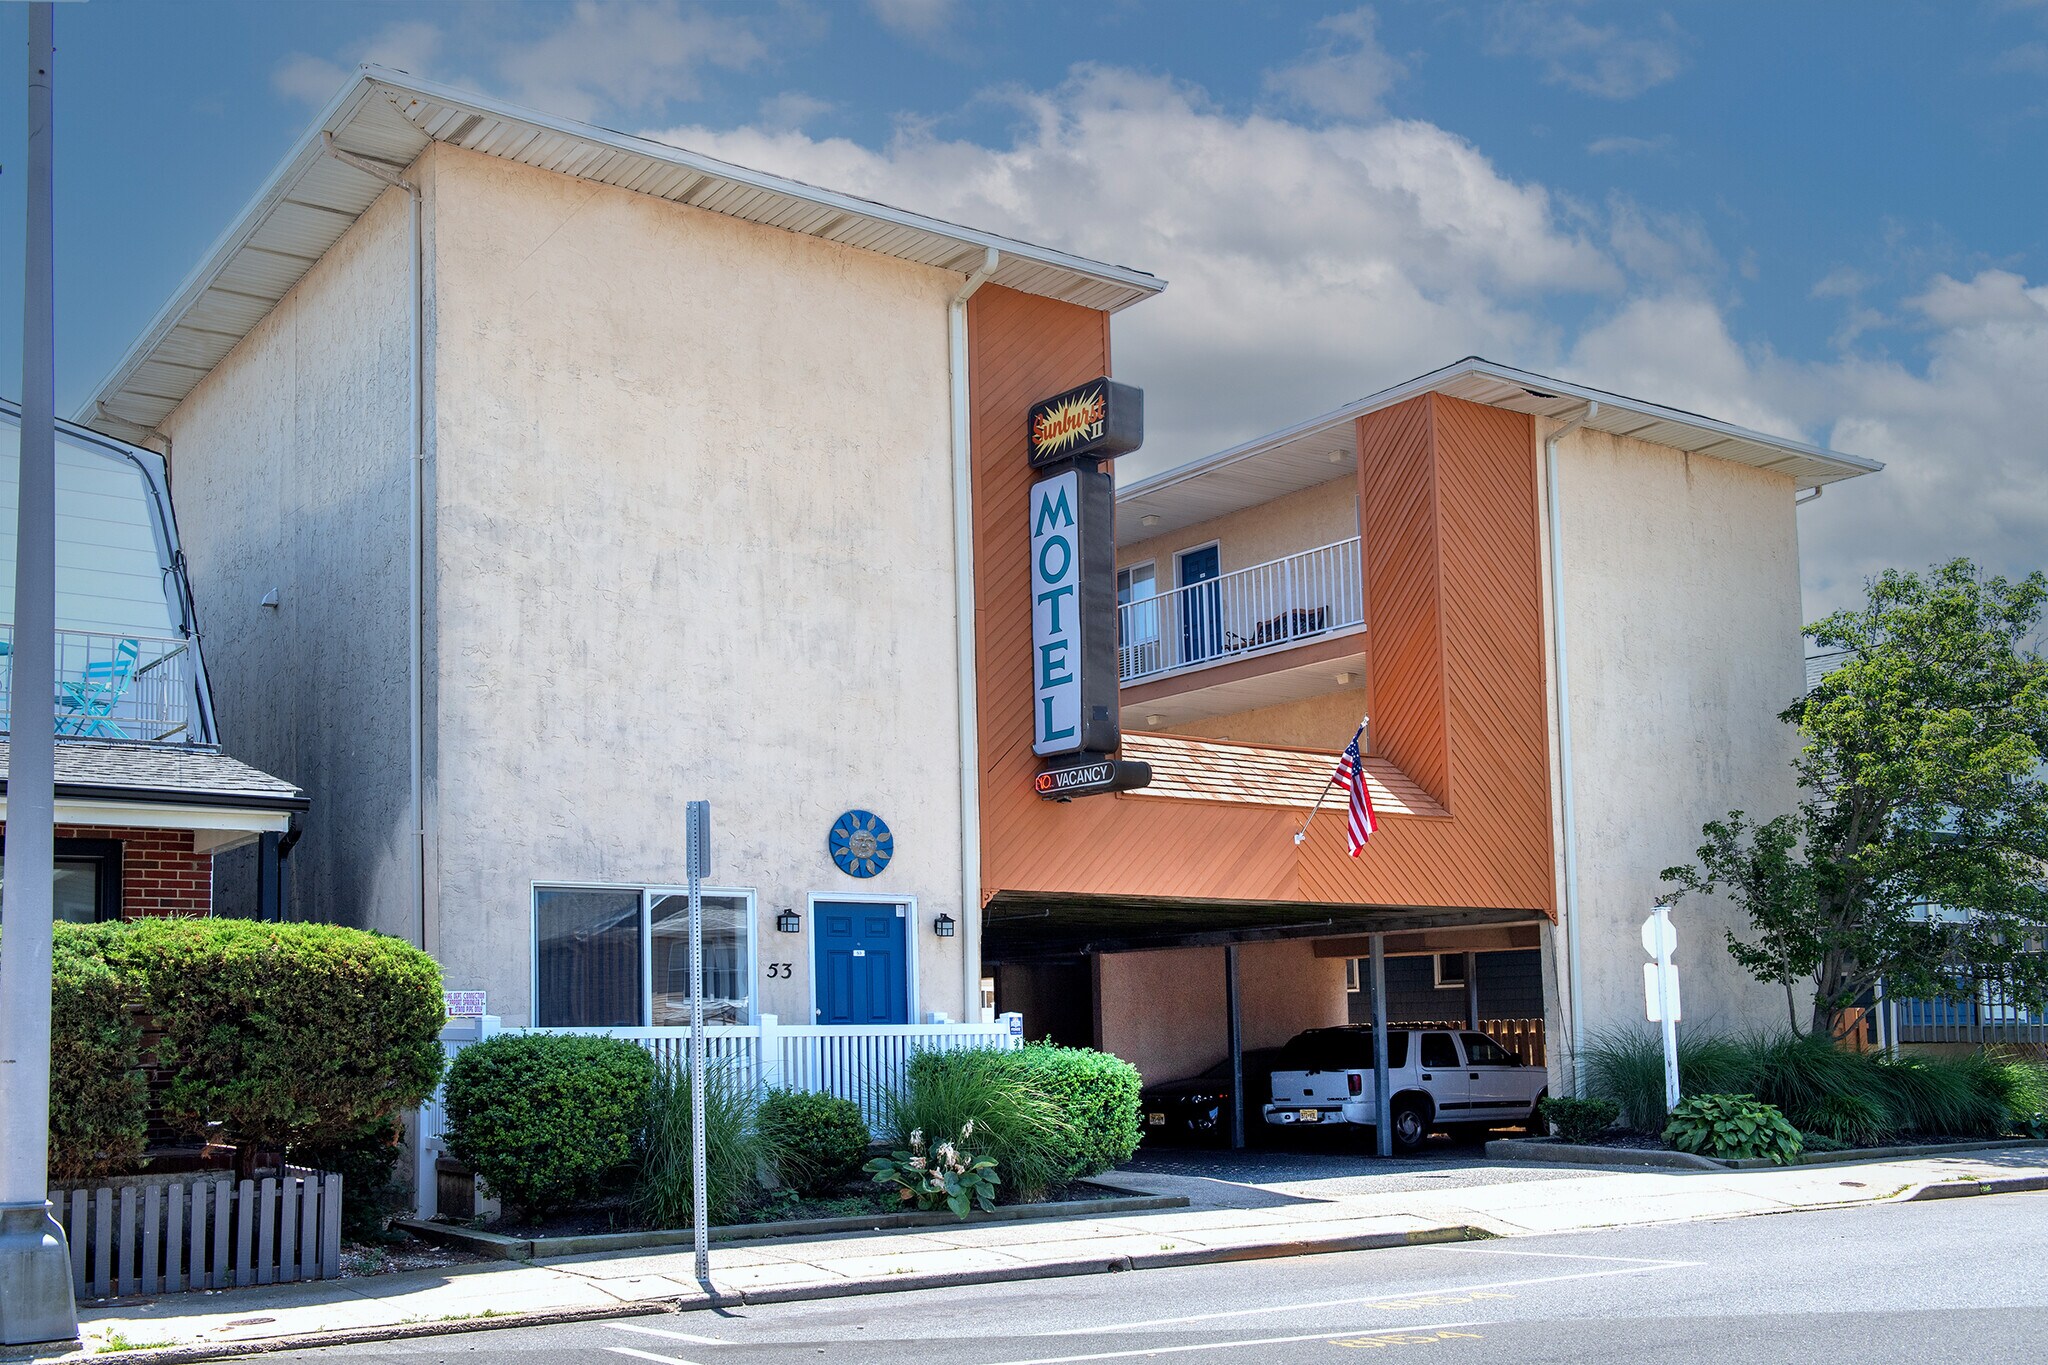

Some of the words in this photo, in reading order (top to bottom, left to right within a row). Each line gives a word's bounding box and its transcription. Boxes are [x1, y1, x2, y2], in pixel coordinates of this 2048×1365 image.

[1032, 394, 1106, 444] Sunburst
[1034, 485, 1075, 743] MOTEL
[1056, 765, 1108, 787] VACANCY
[767, 962, 792, 979] 53
